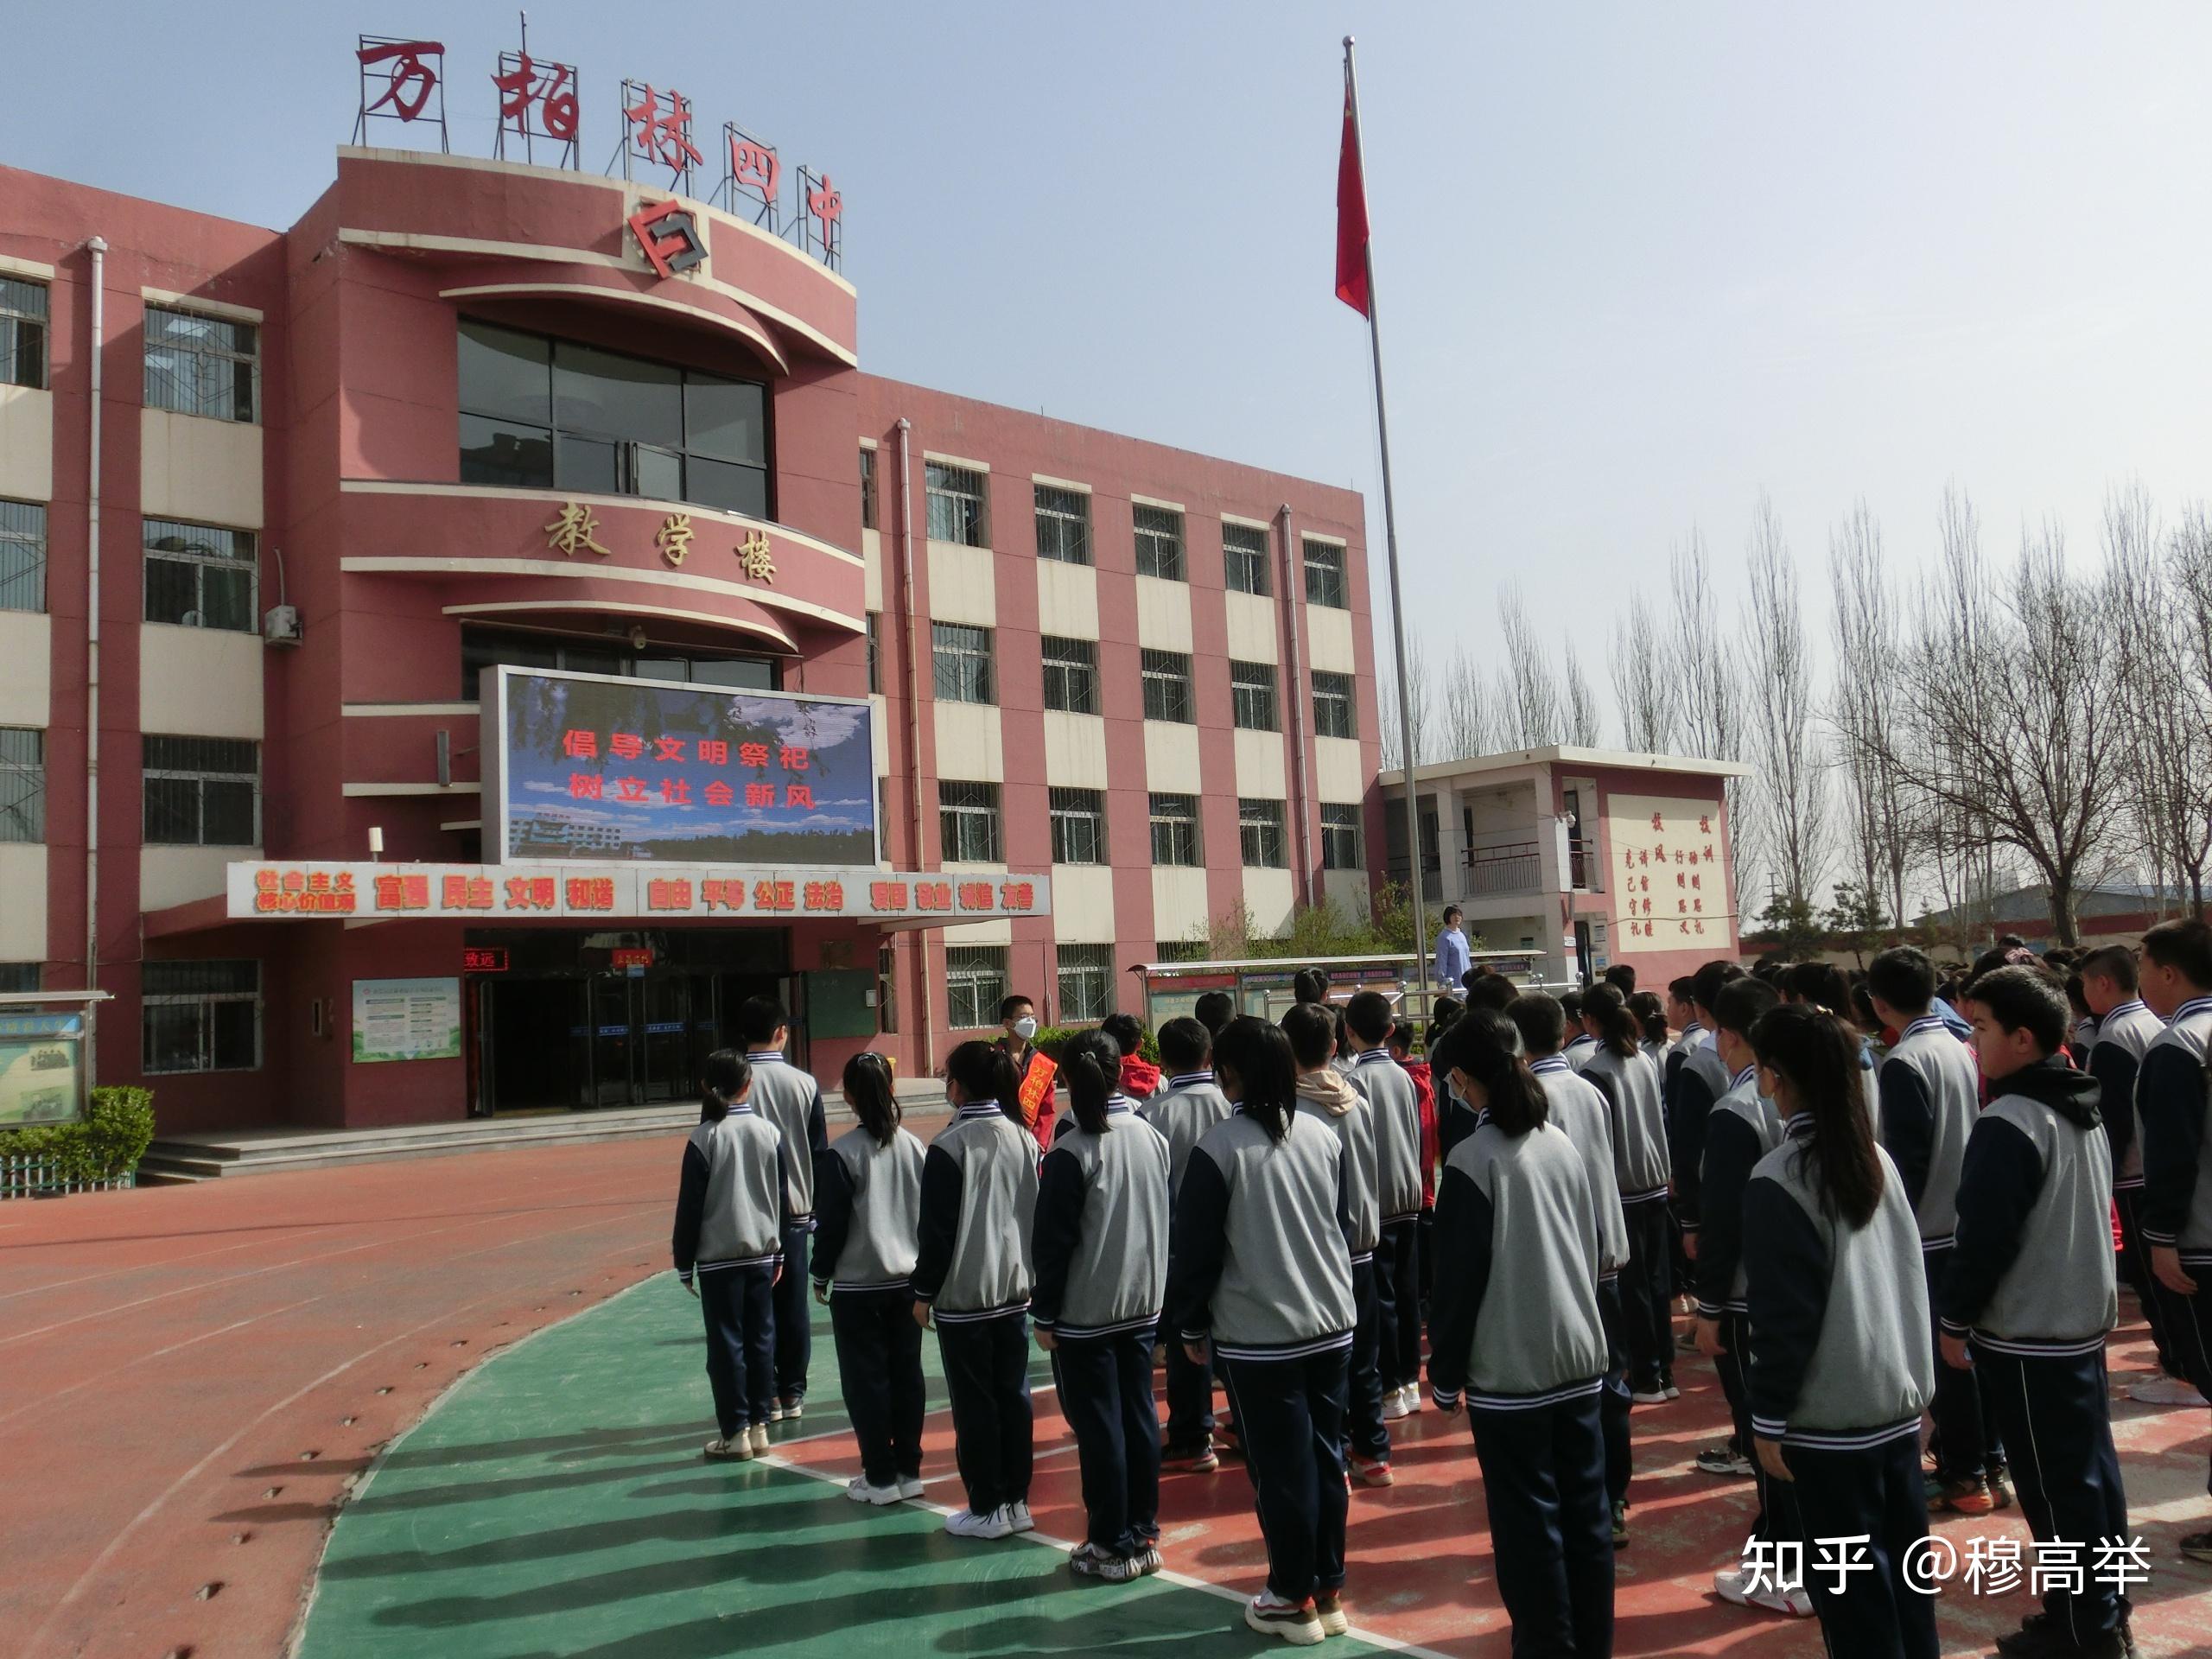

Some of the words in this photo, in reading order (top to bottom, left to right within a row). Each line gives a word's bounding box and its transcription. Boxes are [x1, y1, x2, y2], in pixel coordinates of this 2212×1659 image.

[355, 41, 843, 251] 万柏林四中
[544, 501, 778, 584] 教学楼
[563, 728, 810, 772] 倡导文明祭祀
[569, 772, 817, 810] 树立社会新风
[257, 869, 355, 891] 社会主义
[376, 874, 429, 909] 富强
[442, 875, 493, 909] 民主
[505, 876, 556, 909] 文明
[566, 877, 614, 910] 和谐
[648, 878, 692, 910] 自由
[702, 879, 746, 910] 平等
[753, 880, 796, 911] 公正
[804, 880, 843, 911] 法治
[871, 881, 908, 912] 爱国
[915, 881, 952, 911] 敬业
[959, 881, 995, 911] 诚信
[1001, 881, 1034, 911] 友善
[257, 890, 357, 912] 核心价值观
